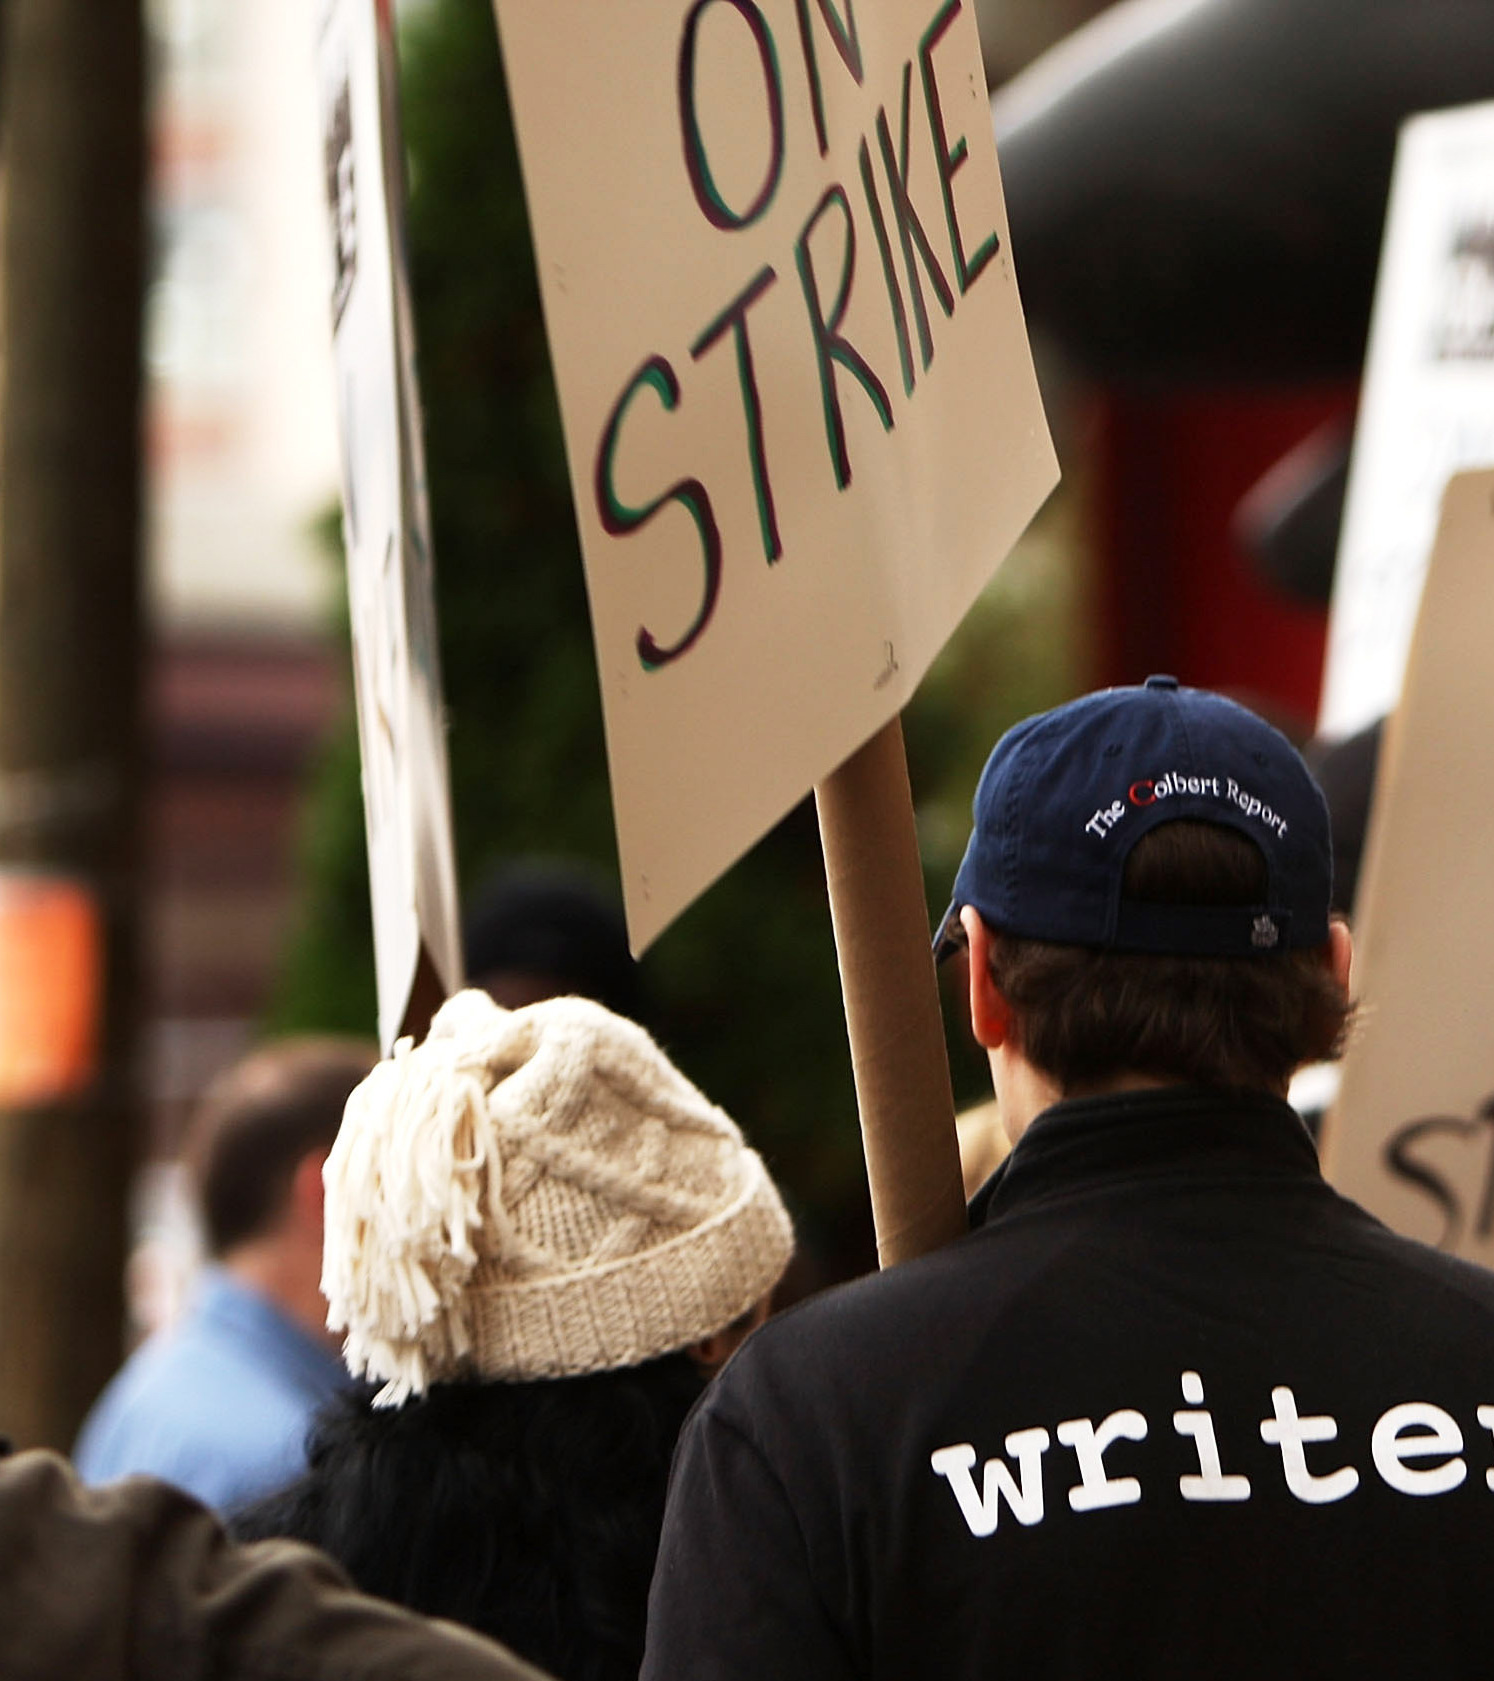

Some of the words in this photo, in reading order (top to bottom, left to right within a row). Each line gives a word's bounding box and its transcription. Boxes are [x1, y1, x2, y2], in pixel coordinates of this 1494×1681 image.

[676, 0, 863, 232] ON
[594, 0, 1000, 672] STRIKE
[1085, 799, 1126, 840] The
[1128, 771, 1220, 807] Colbert
[1226, 777, 1288, 840] Report
